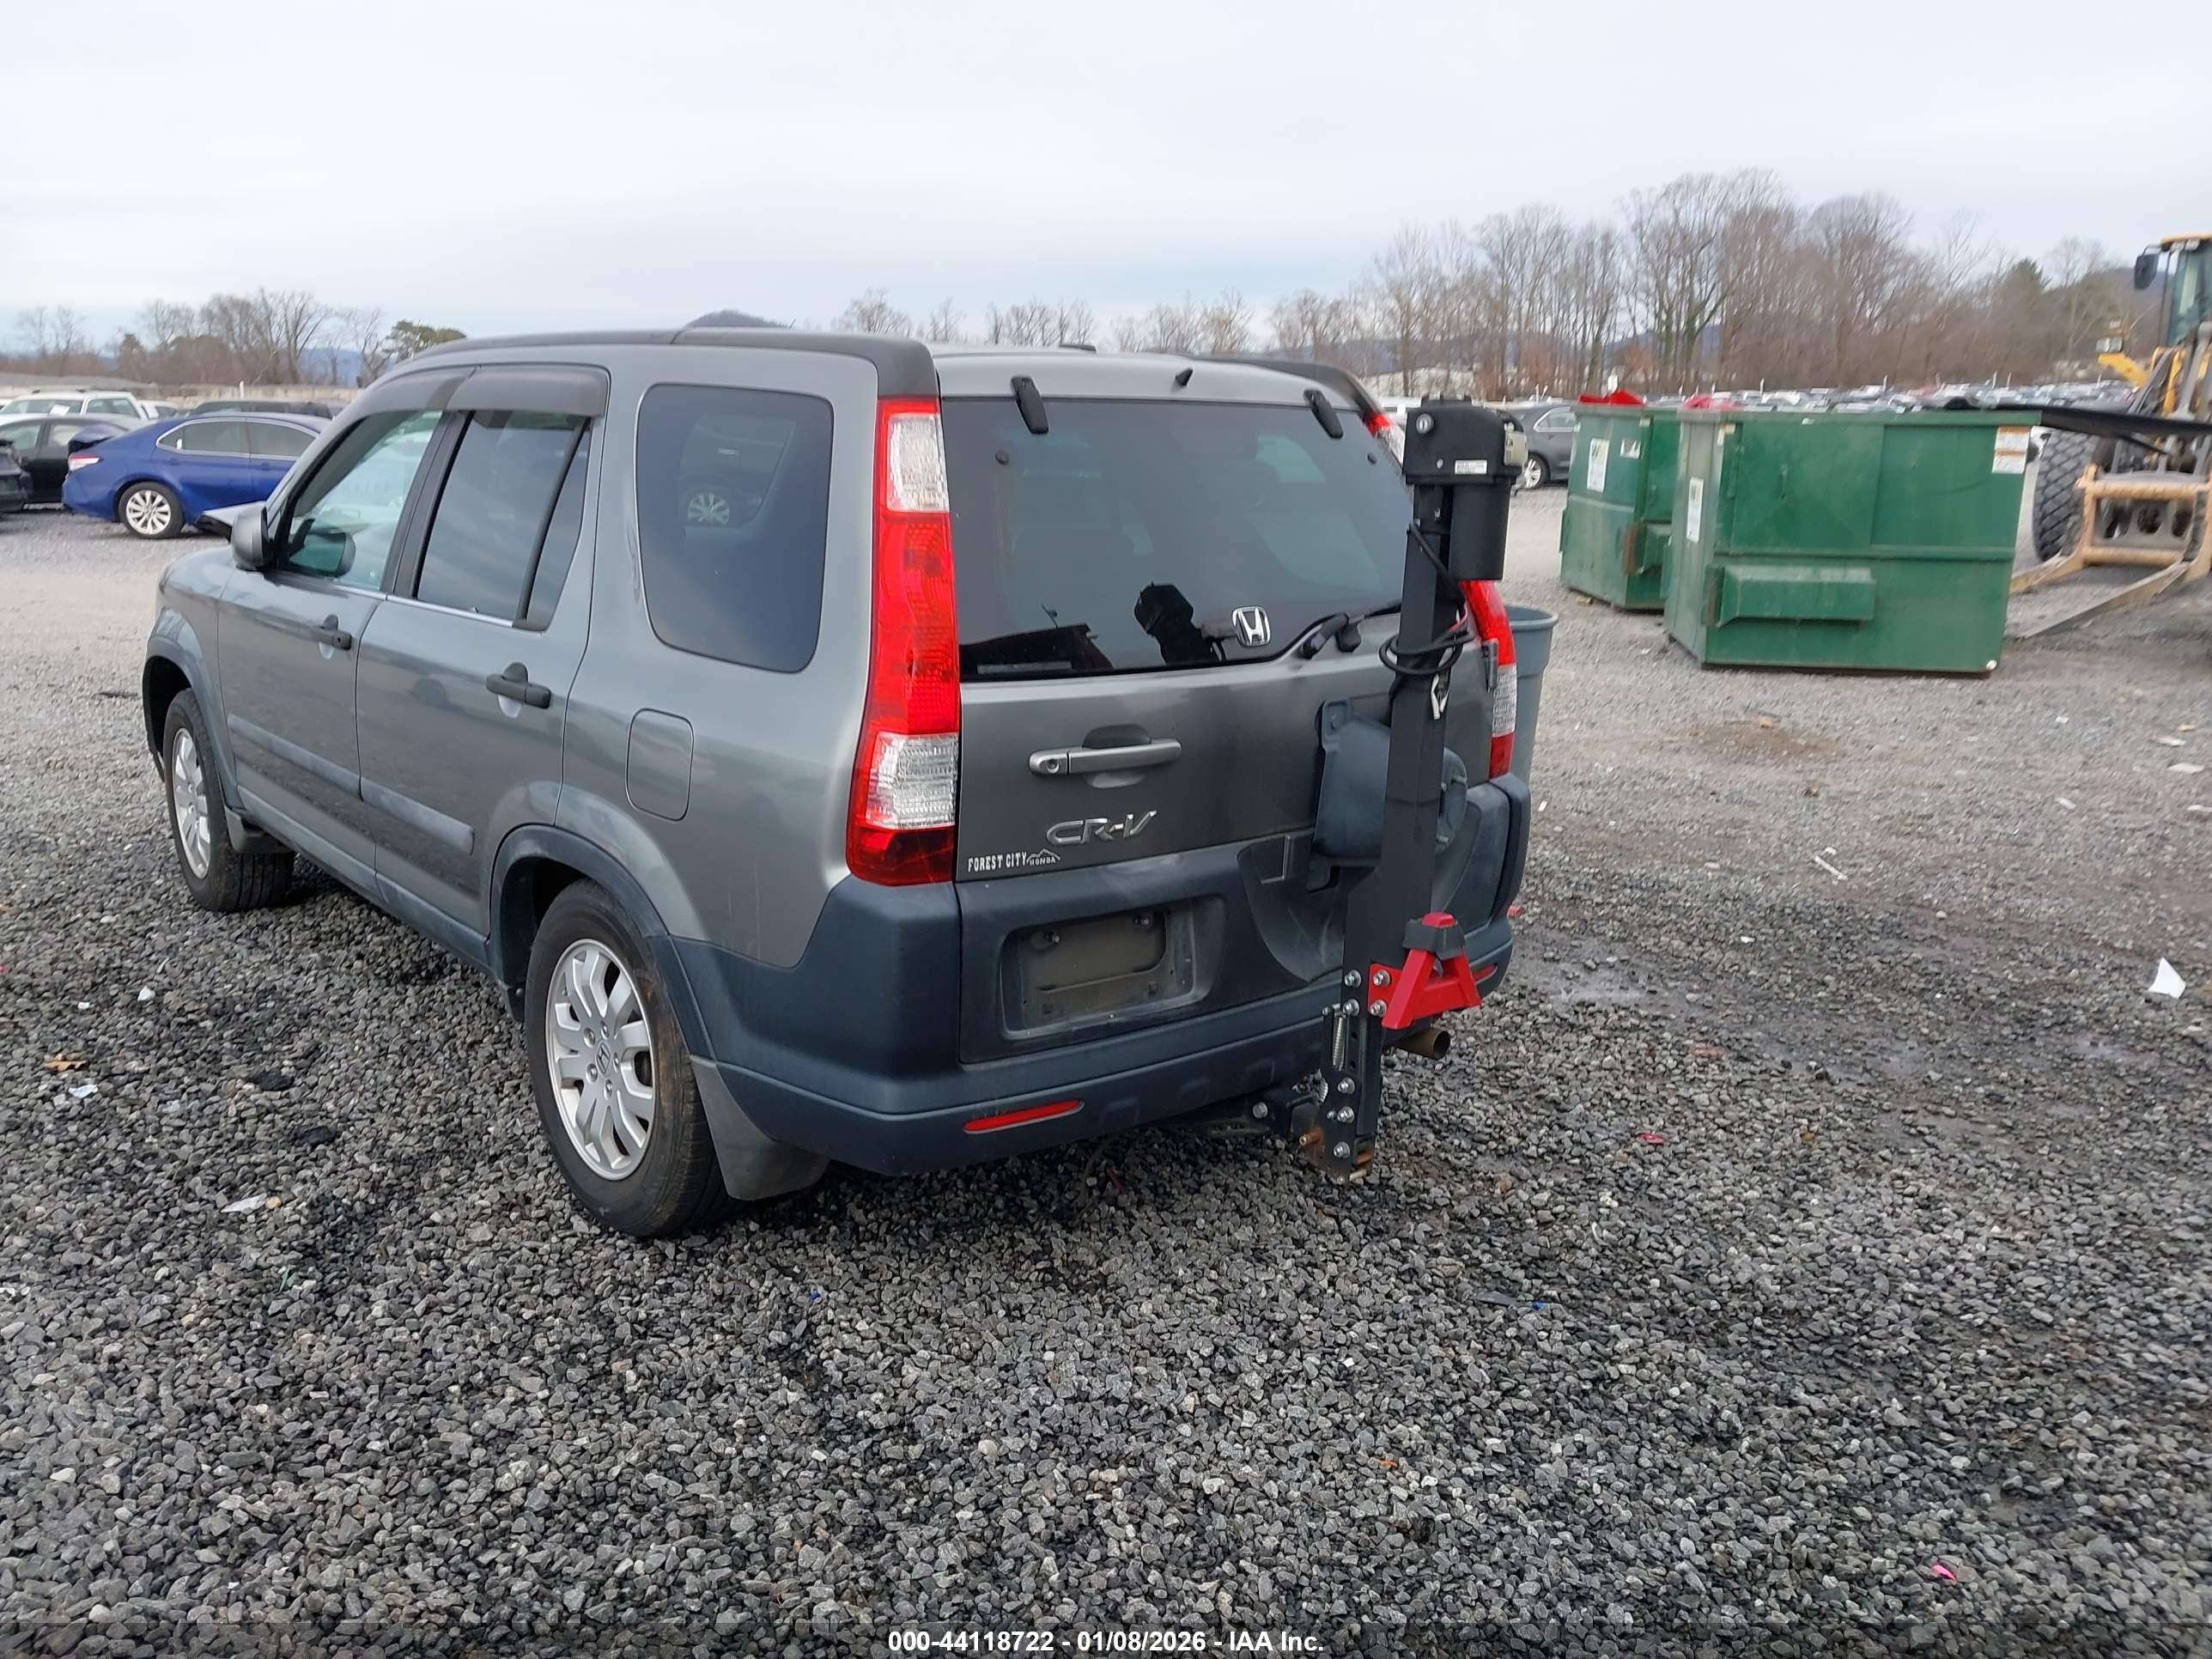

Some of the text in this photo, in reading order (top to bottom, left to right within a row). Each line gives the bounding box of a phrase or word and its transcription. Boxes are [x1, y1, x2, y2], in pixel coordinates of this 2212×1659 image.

[1046, 810, 1158, 845] CR-V
[968, 854, 1004, 872] FOREST
[1006, 851, 1027, 868] CITY
